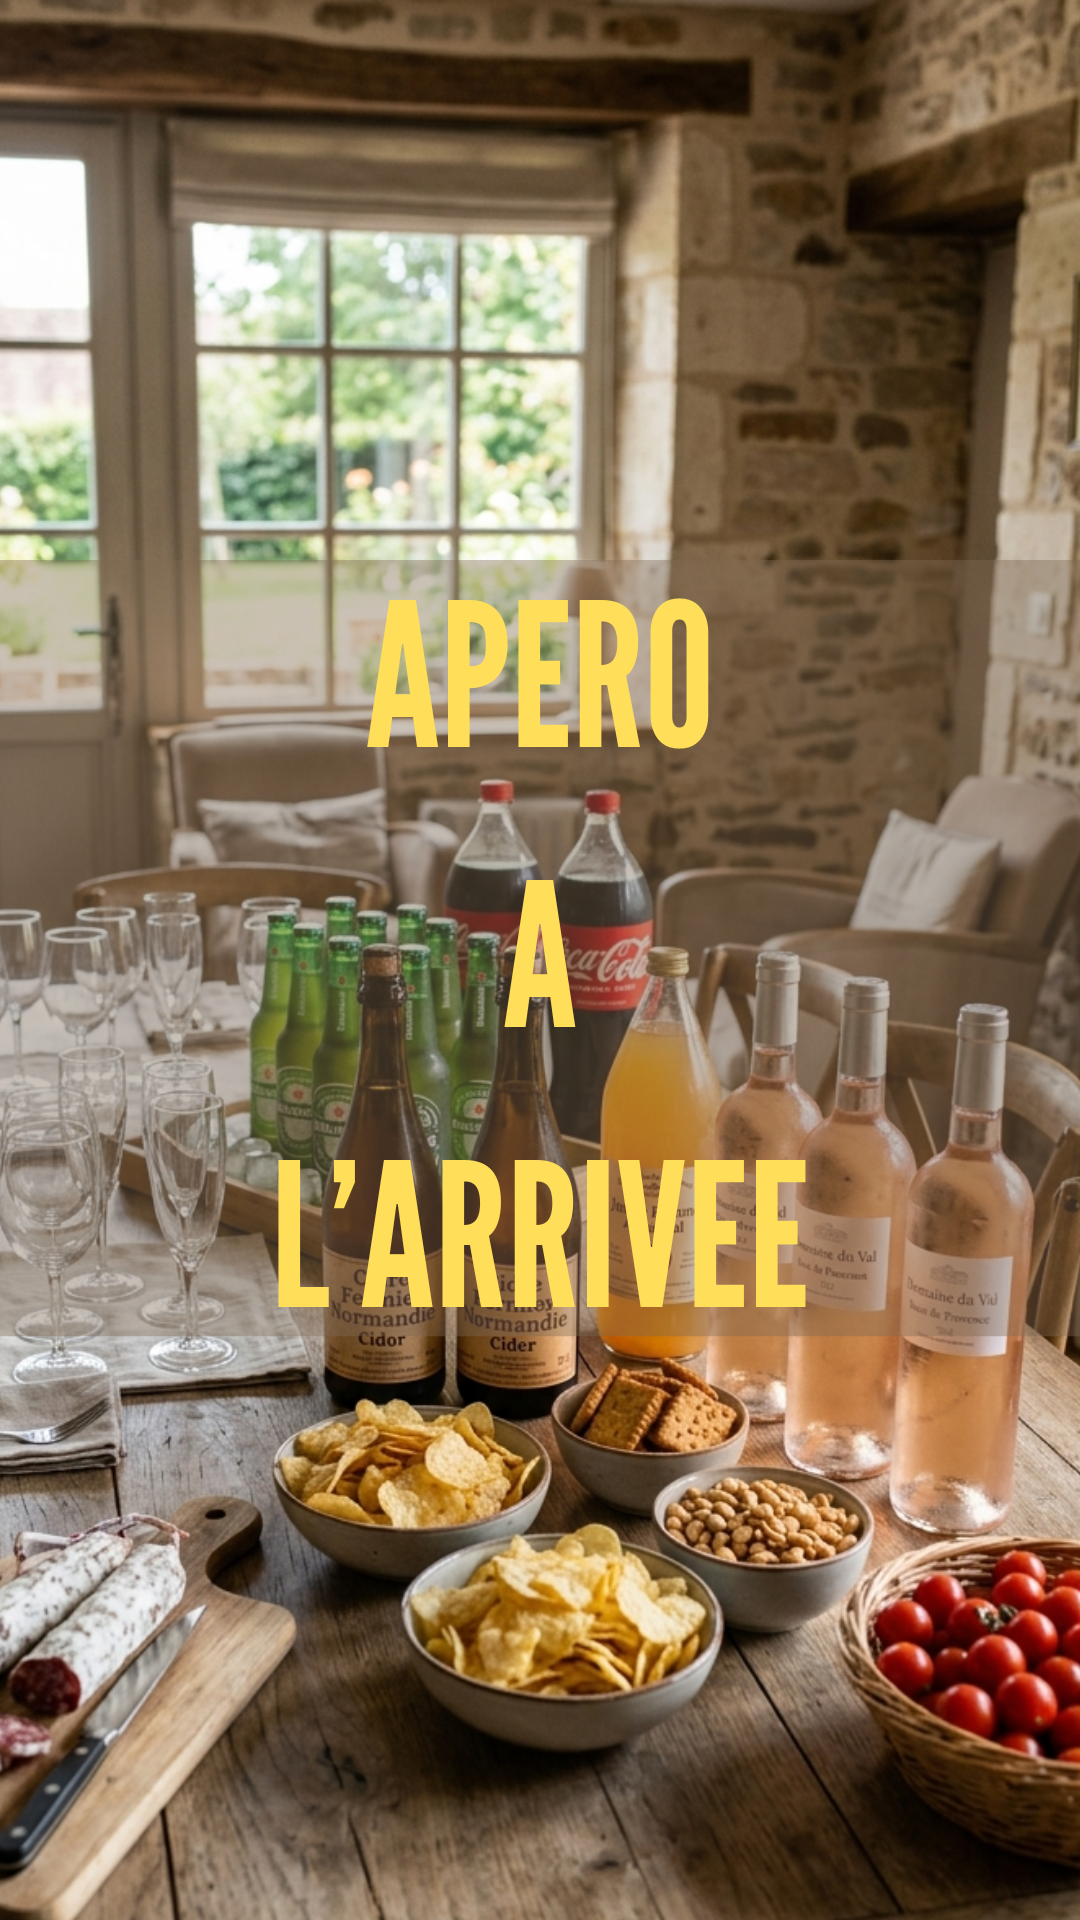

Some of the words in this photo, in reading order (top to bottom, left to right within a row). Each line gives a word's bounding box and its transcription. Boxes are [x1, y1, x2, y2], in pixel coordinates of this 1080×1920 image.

[330, 1301, 436, 1328] Normandie
[464, 1305, 568, 1333] Normandie
[490, 1336, 537, 1352] Cider
